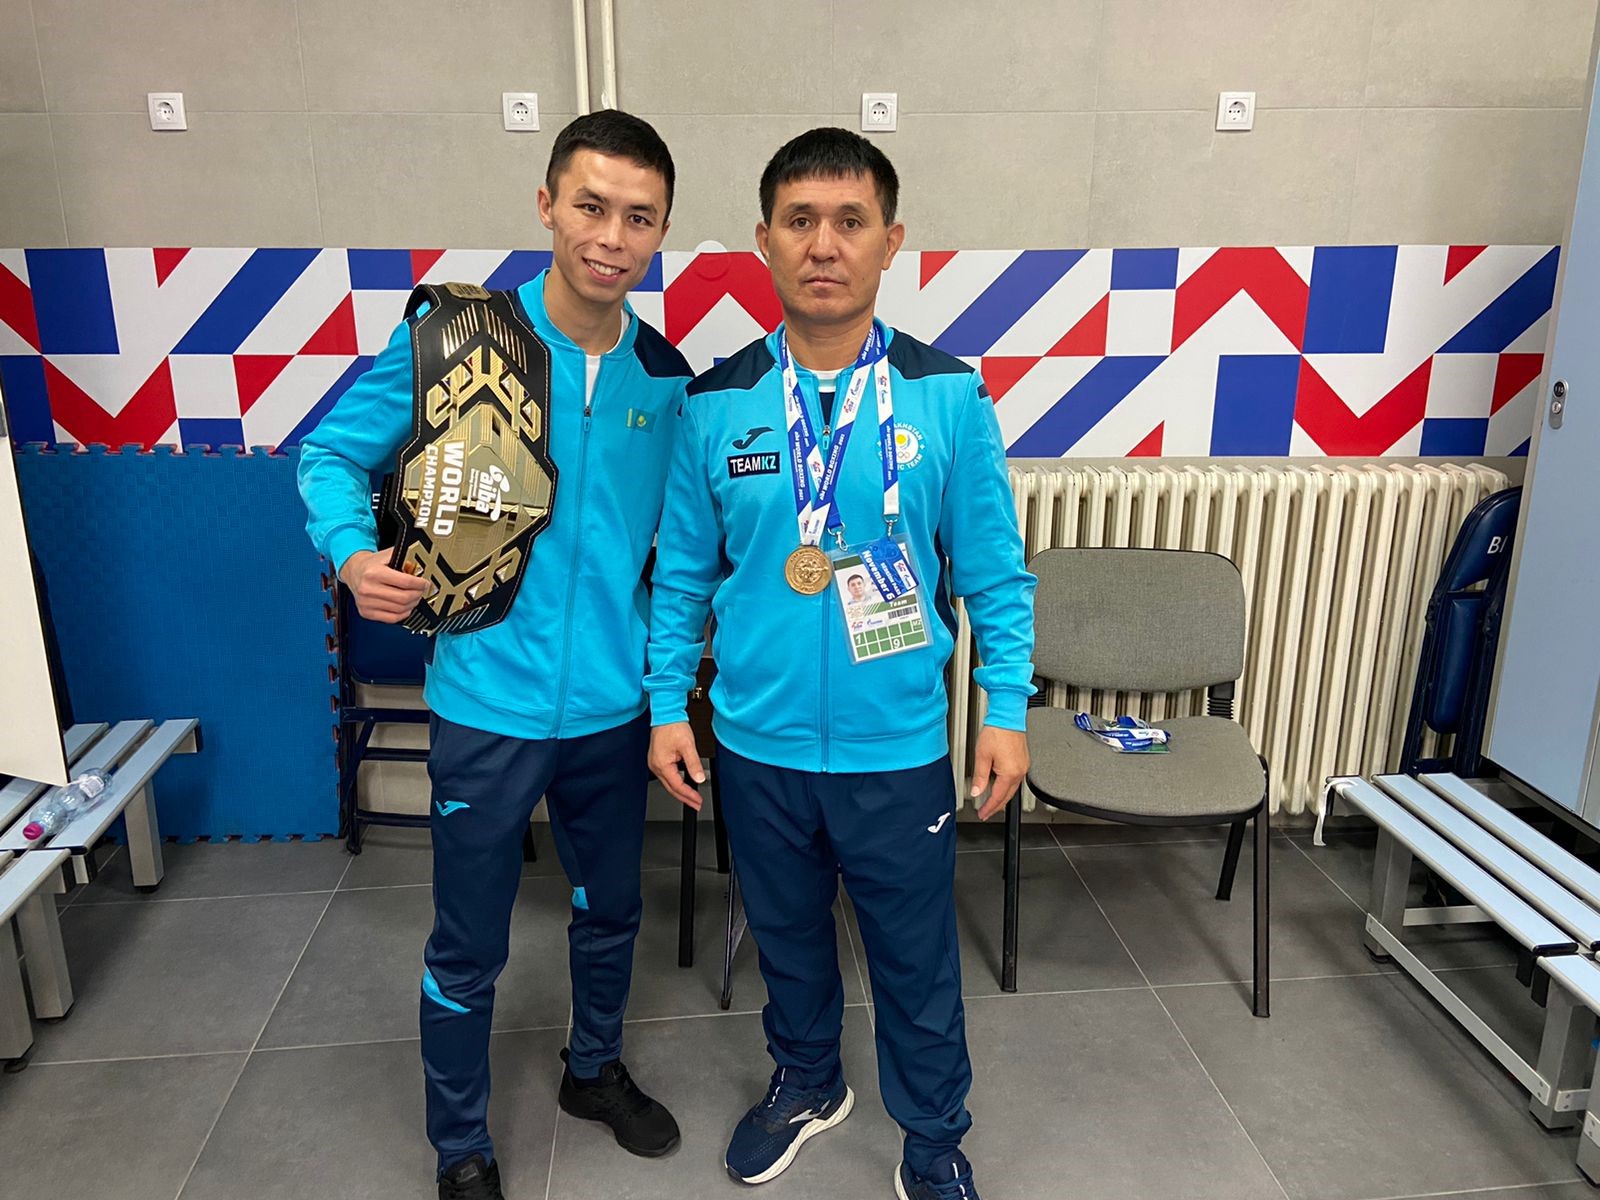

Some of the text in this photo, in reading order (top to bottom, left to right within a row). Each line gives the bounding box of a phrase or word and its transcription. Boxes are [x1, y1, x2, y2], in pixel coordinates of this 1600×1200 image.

[415, 444, 438, 528] CHAMPION
[433, 441, 465, 536] WORLD
[475, 471, 497, 513] aiba
[862, 549, 896, 601] November 6
[893, 638, 901, 650] 9
